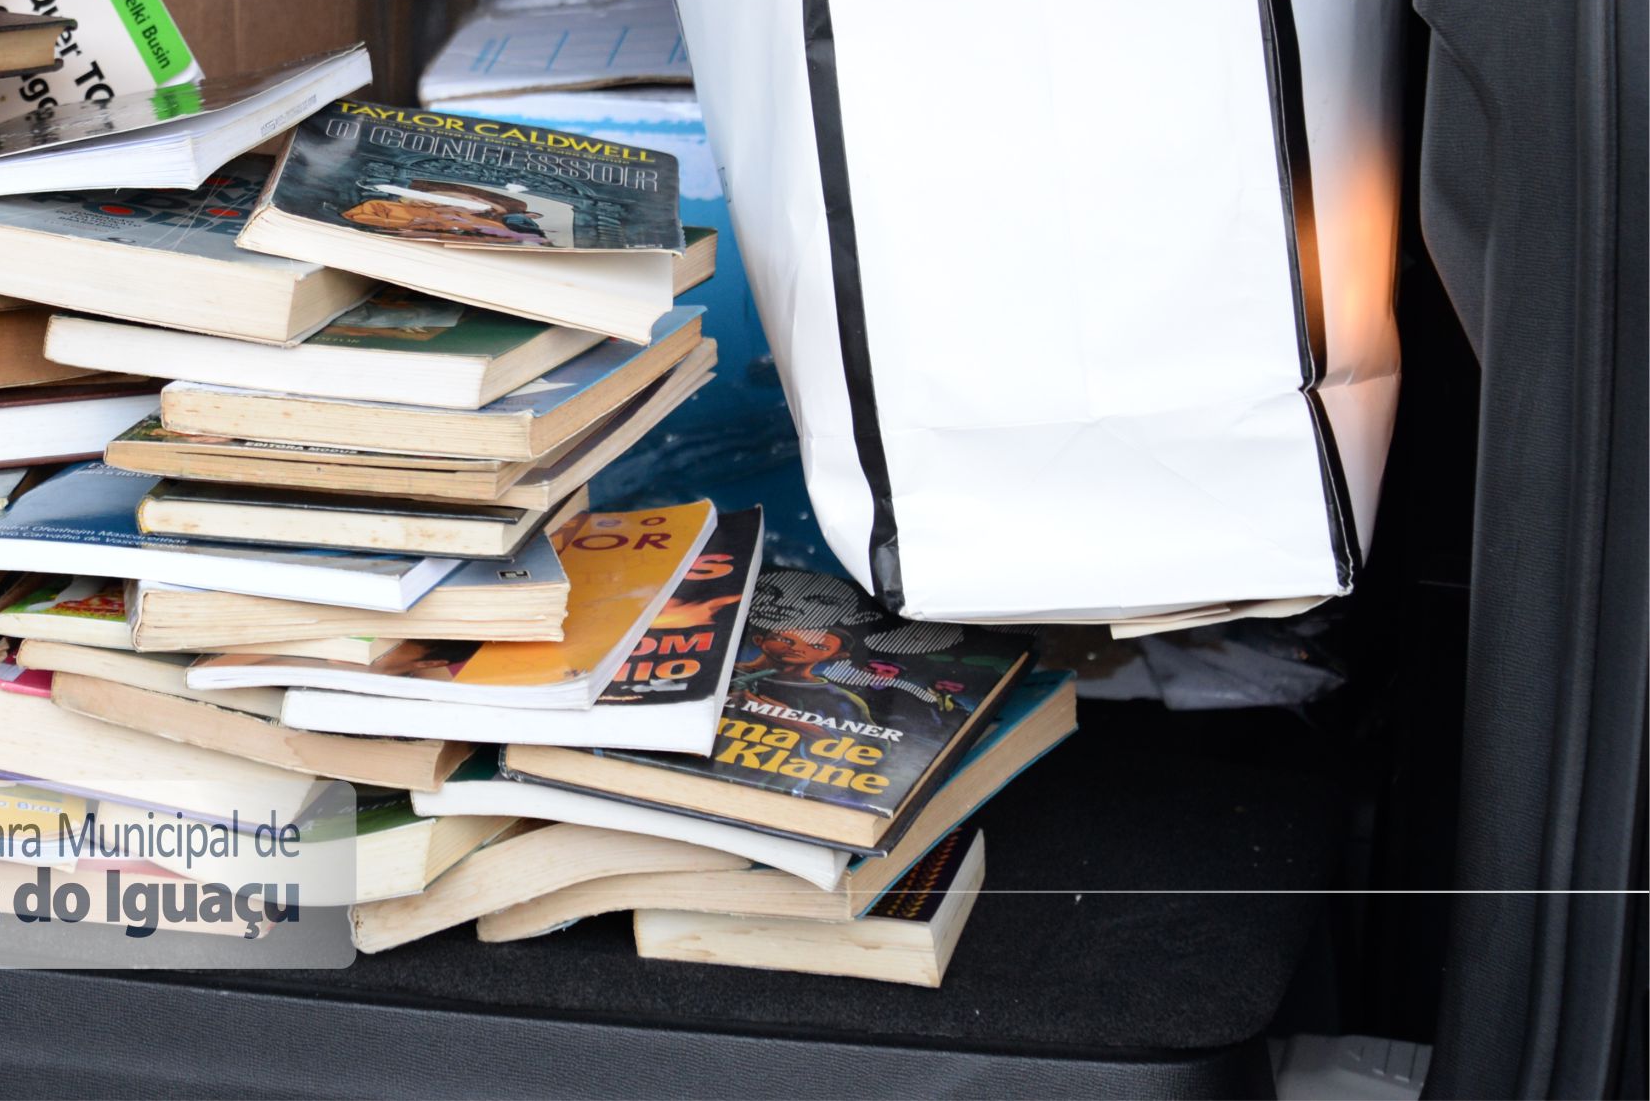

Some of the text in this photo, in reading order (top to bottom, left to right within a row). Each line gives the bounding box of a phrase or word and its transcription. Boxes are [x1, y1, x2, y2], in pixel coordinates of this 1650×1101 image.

[141, 25, 172, 70] Busin
[335, 100, 465, 131] TAYLOR
[474, 122, 657, 164] CALDWELL
[326, 118, 658, 193] O CONFESSOR
[244, 441, 304, 451] EDITORA
[21, 531, 82, 541] Carvalho
[83, 535, 101, 543] de
[741, 699, 904, 743] MIEDANER
[715, 740, 891, 796] Klane
[810, 736, 884, 767] de
